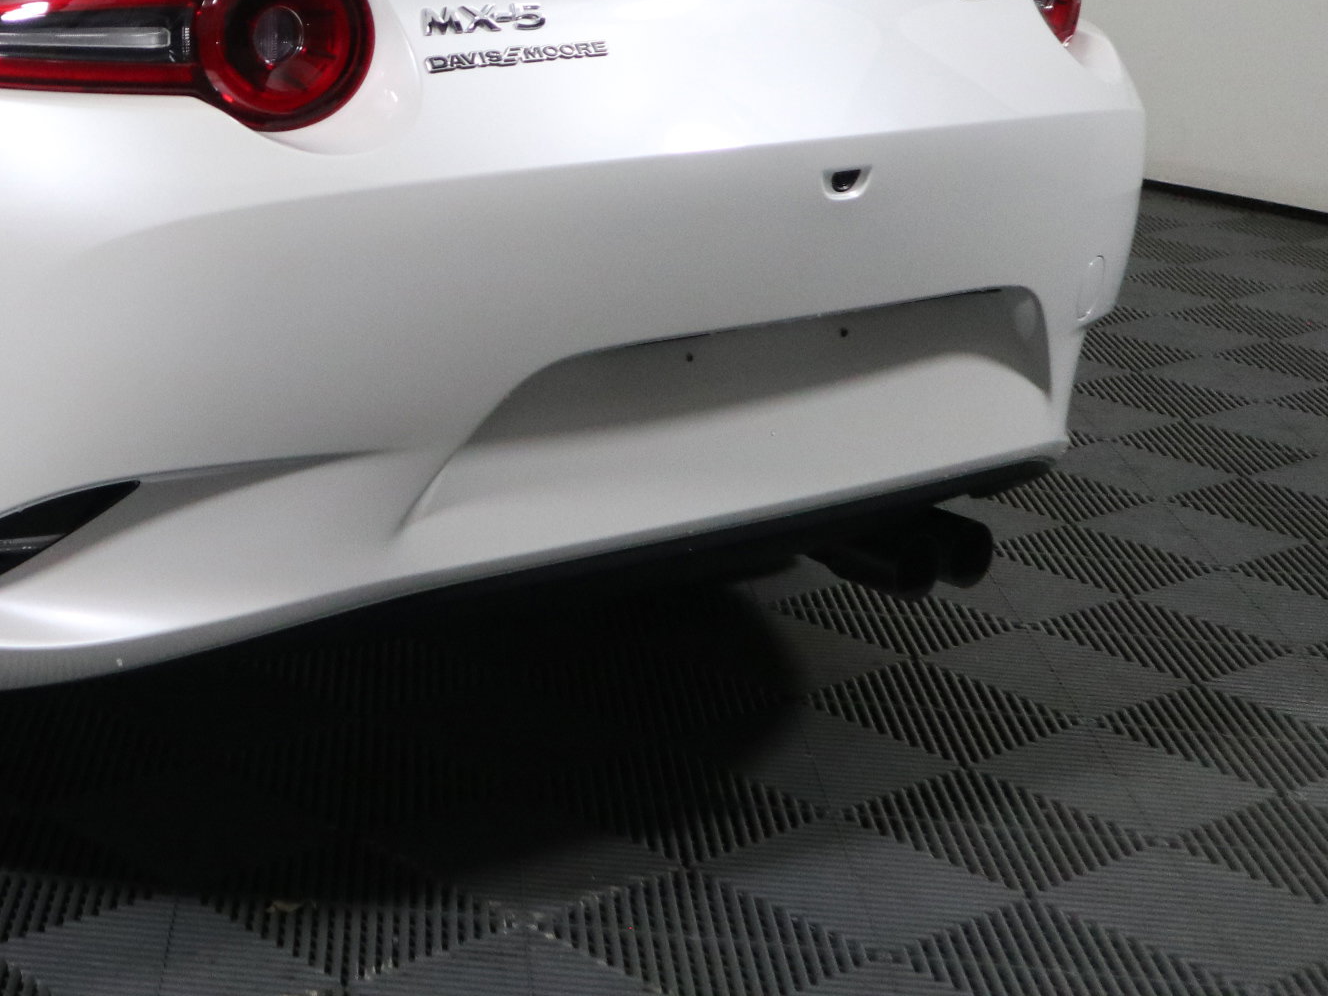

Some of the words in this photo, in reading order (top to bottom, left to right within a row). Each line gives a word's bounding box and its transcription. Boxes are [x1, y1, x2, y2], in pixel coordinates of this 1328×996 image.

[422, 3, 547, 36] MX-5
[425, 49, 503, 73] DAVIS
[522, 40, 609, 63] MOORE
